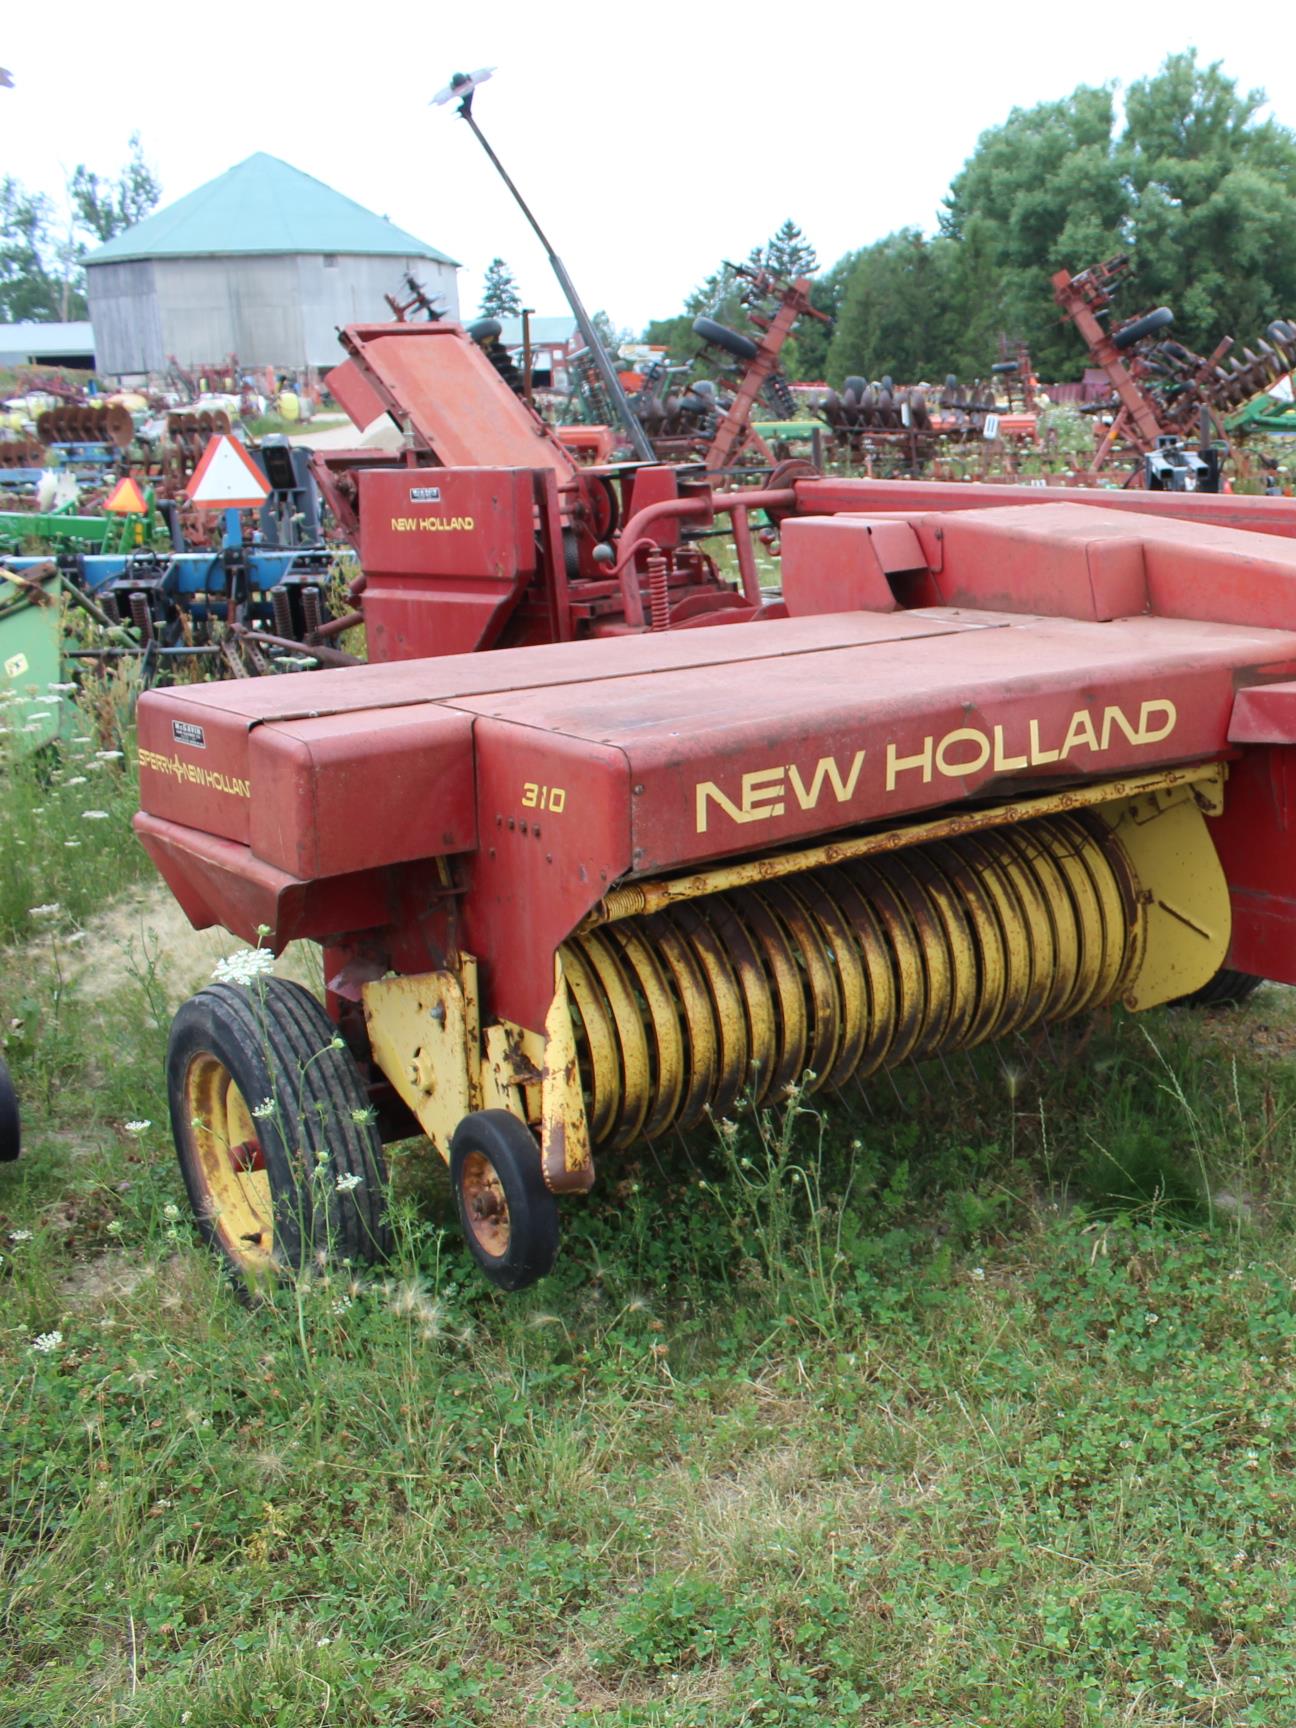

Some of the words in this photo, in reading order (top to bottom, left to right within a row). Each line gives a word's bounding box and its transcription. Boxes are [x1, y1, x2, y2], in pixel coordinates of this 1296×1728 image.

[391, 518, 416, 531] NEW
[419, 517, 474, 531] HOLLAND
[138, 749, 173, 775] SPERRY
[182, 762, 206, 786] NEW
[204, 769, 251, 798] HOLLAN
[696, 750, 866, 834] NEW
[886, 698, 1178, 792] HOLLAND
[521, 782, 566, 813] 310
